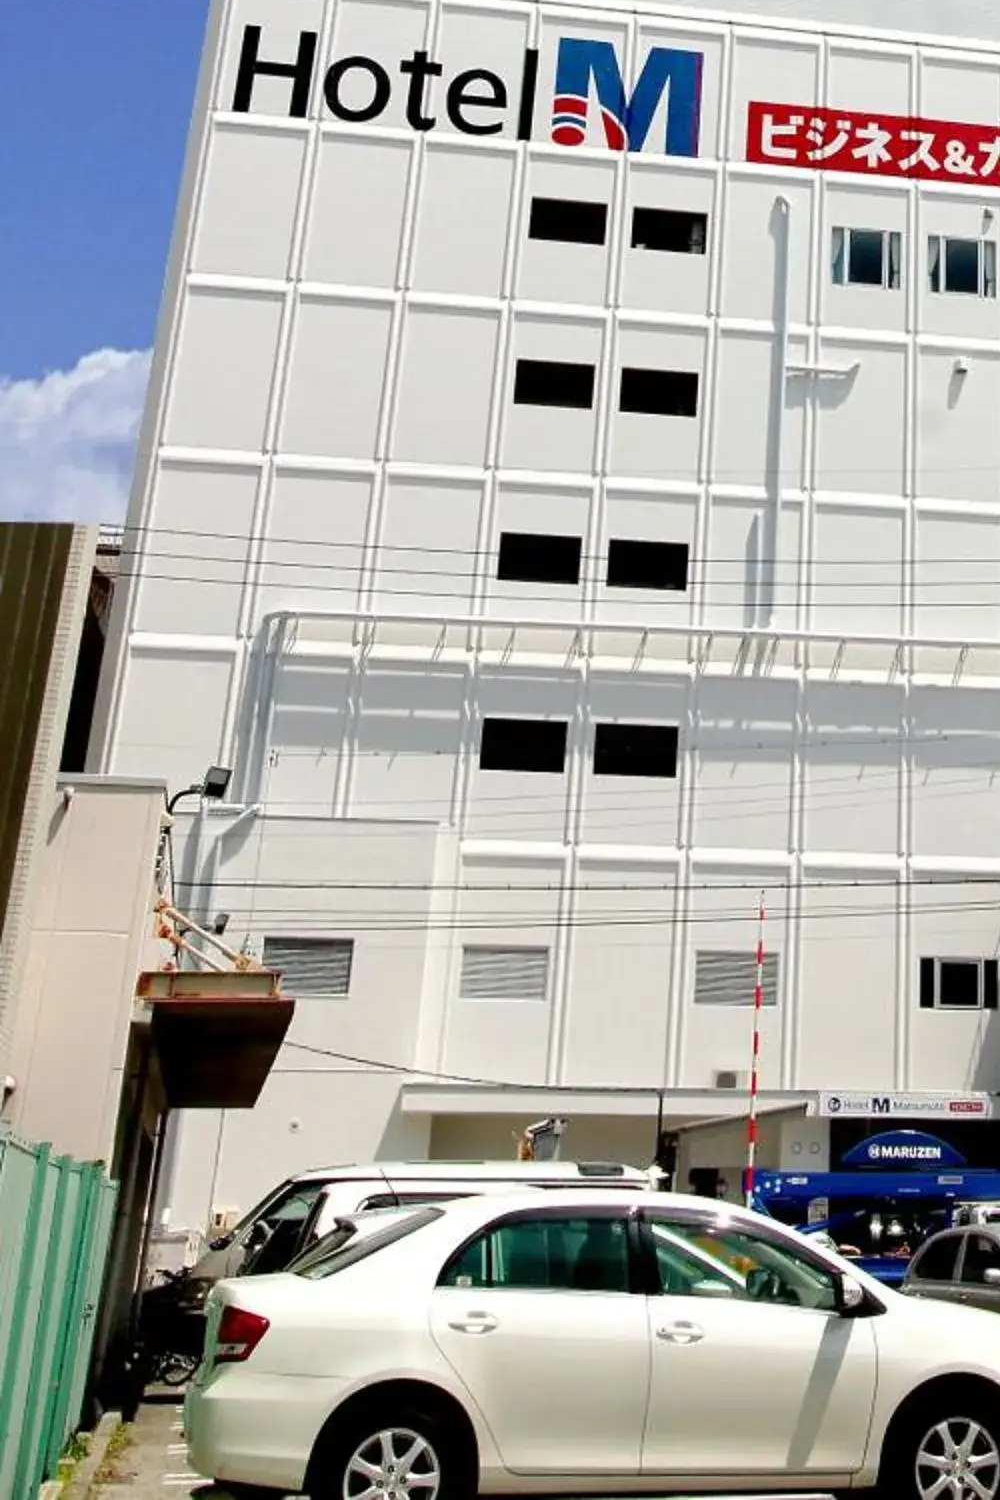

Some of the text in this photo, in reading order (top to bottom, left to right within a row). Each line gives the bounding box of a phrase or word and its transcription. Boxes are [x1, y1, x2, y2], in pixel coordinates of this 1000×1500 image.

[232, 25, 706, 157] Hotel M
[872, 1098, 890, 1113] M
[881, 1145, 941, 1160] MARUZEN
